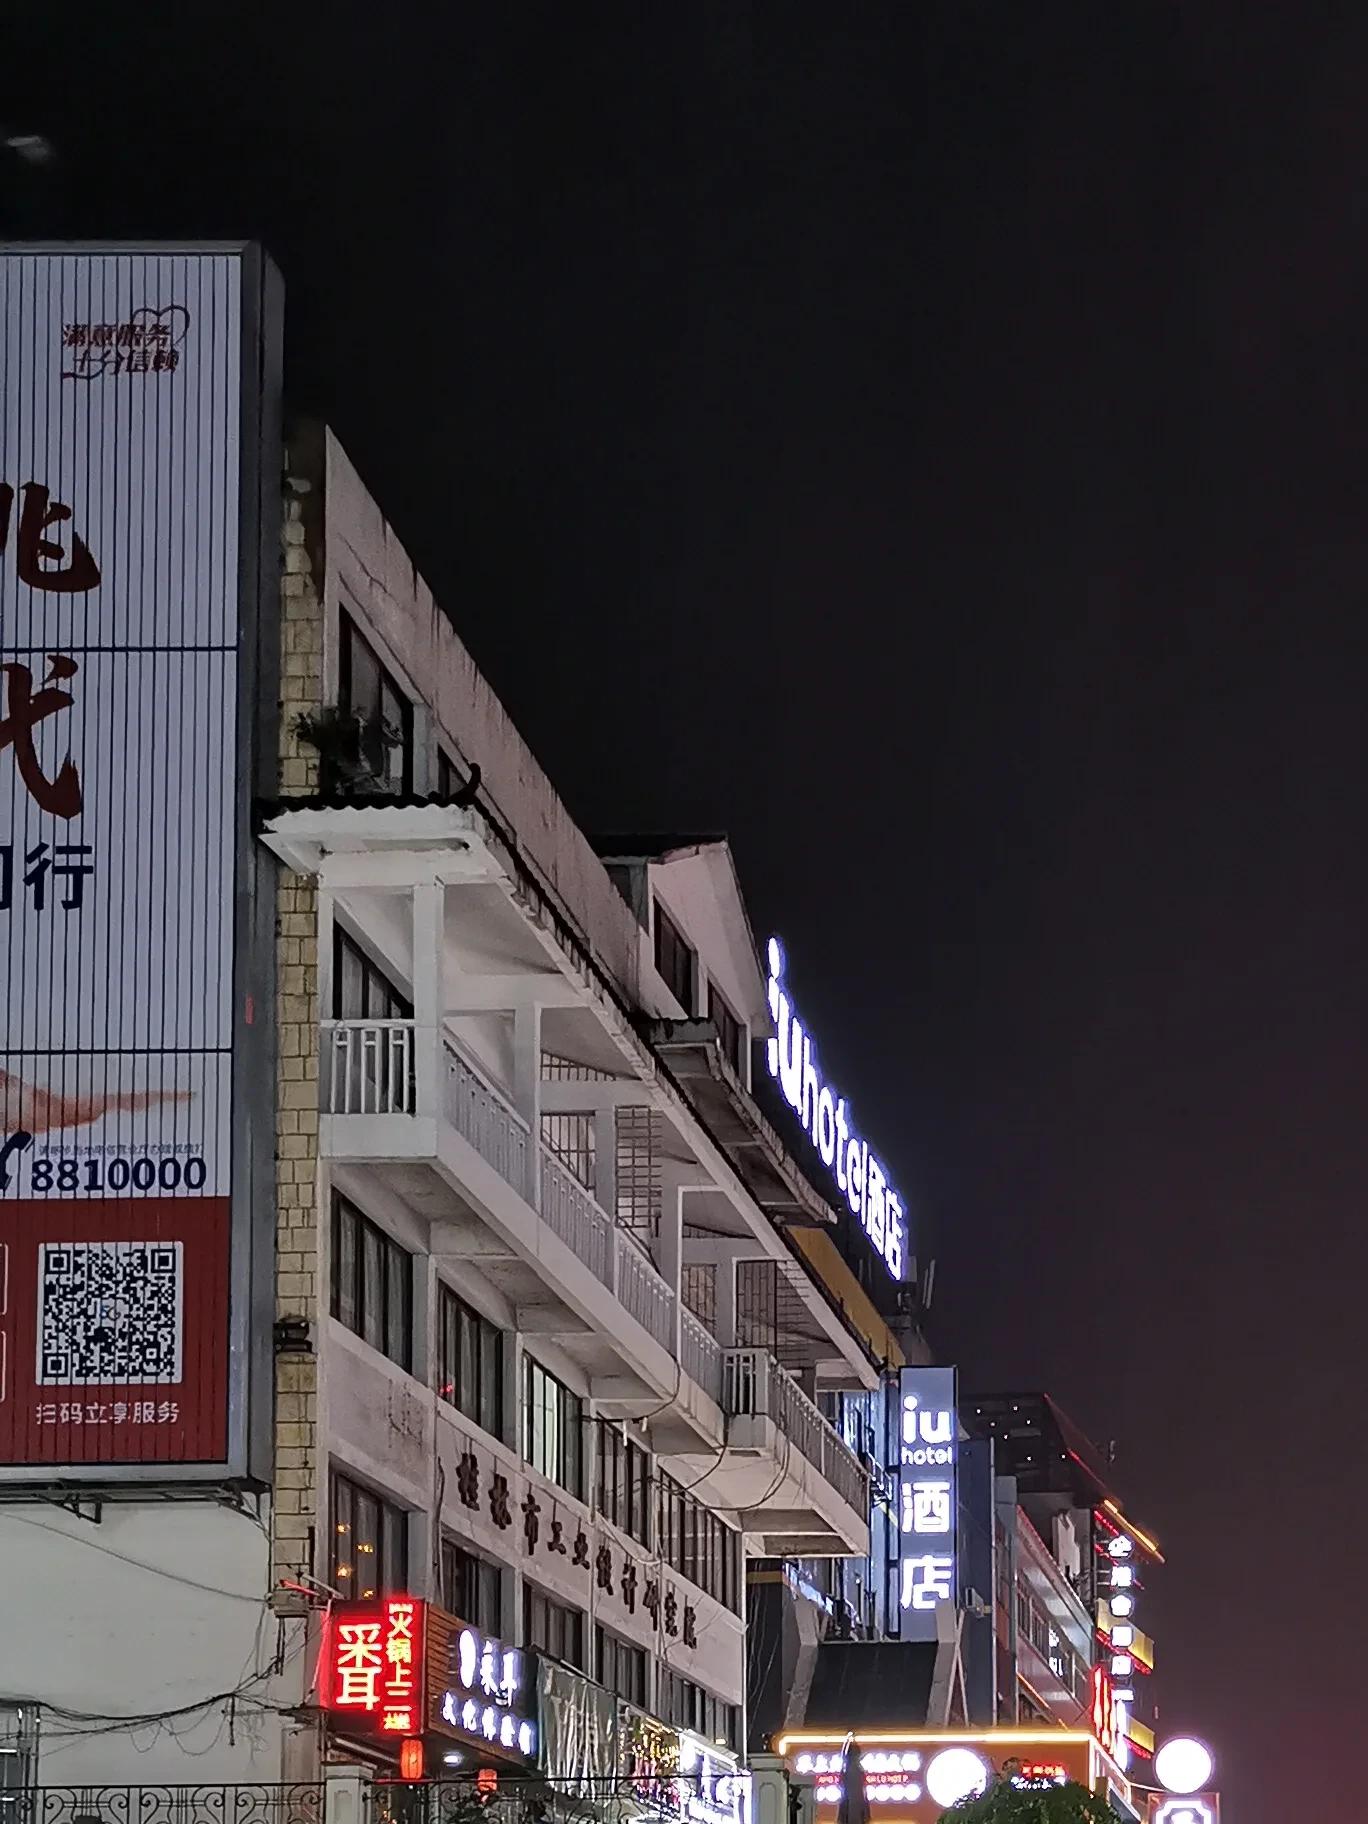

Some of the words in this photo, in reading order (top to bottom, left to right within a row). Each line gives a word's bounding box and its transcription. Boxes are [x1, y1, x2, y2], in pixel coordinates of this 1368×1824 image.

[72, 349, 180, 376] 十分信赖
[31, 1157, 207, 1192] 8810000
[35, 1400, 180, 1425] 扫码立享服务
[901, 1446, 953, 1466] hotel
[900, 1481, 953, 1610] 酒店
[335, 1622, 383, 1711] 采耳
